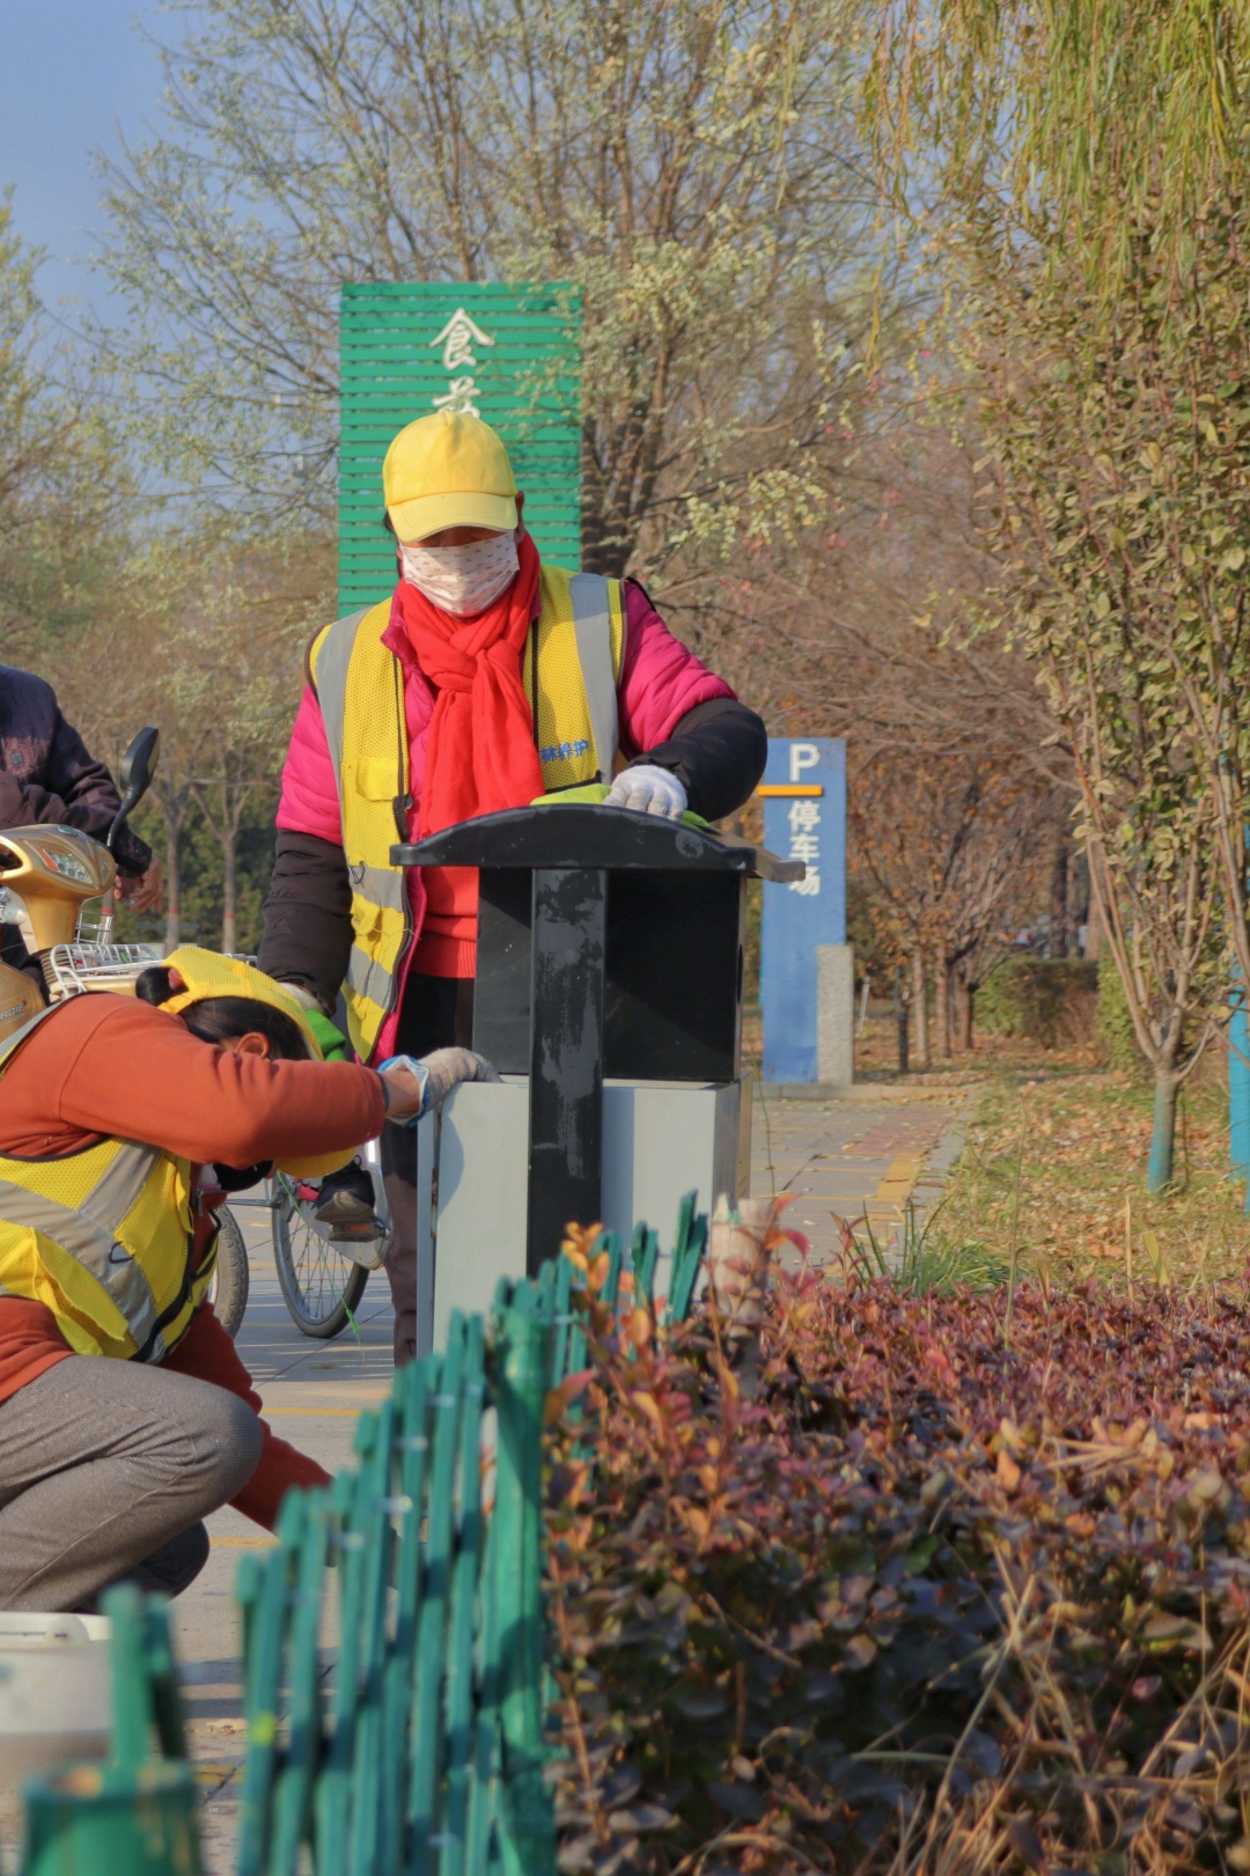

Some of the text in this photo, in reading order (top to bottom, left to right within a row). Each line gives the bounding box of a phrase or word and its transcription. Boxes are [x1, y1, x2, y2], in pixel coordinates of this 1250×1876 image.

[789, 743, 820, 782] P
[788, 800, 821, 896] 停车场
